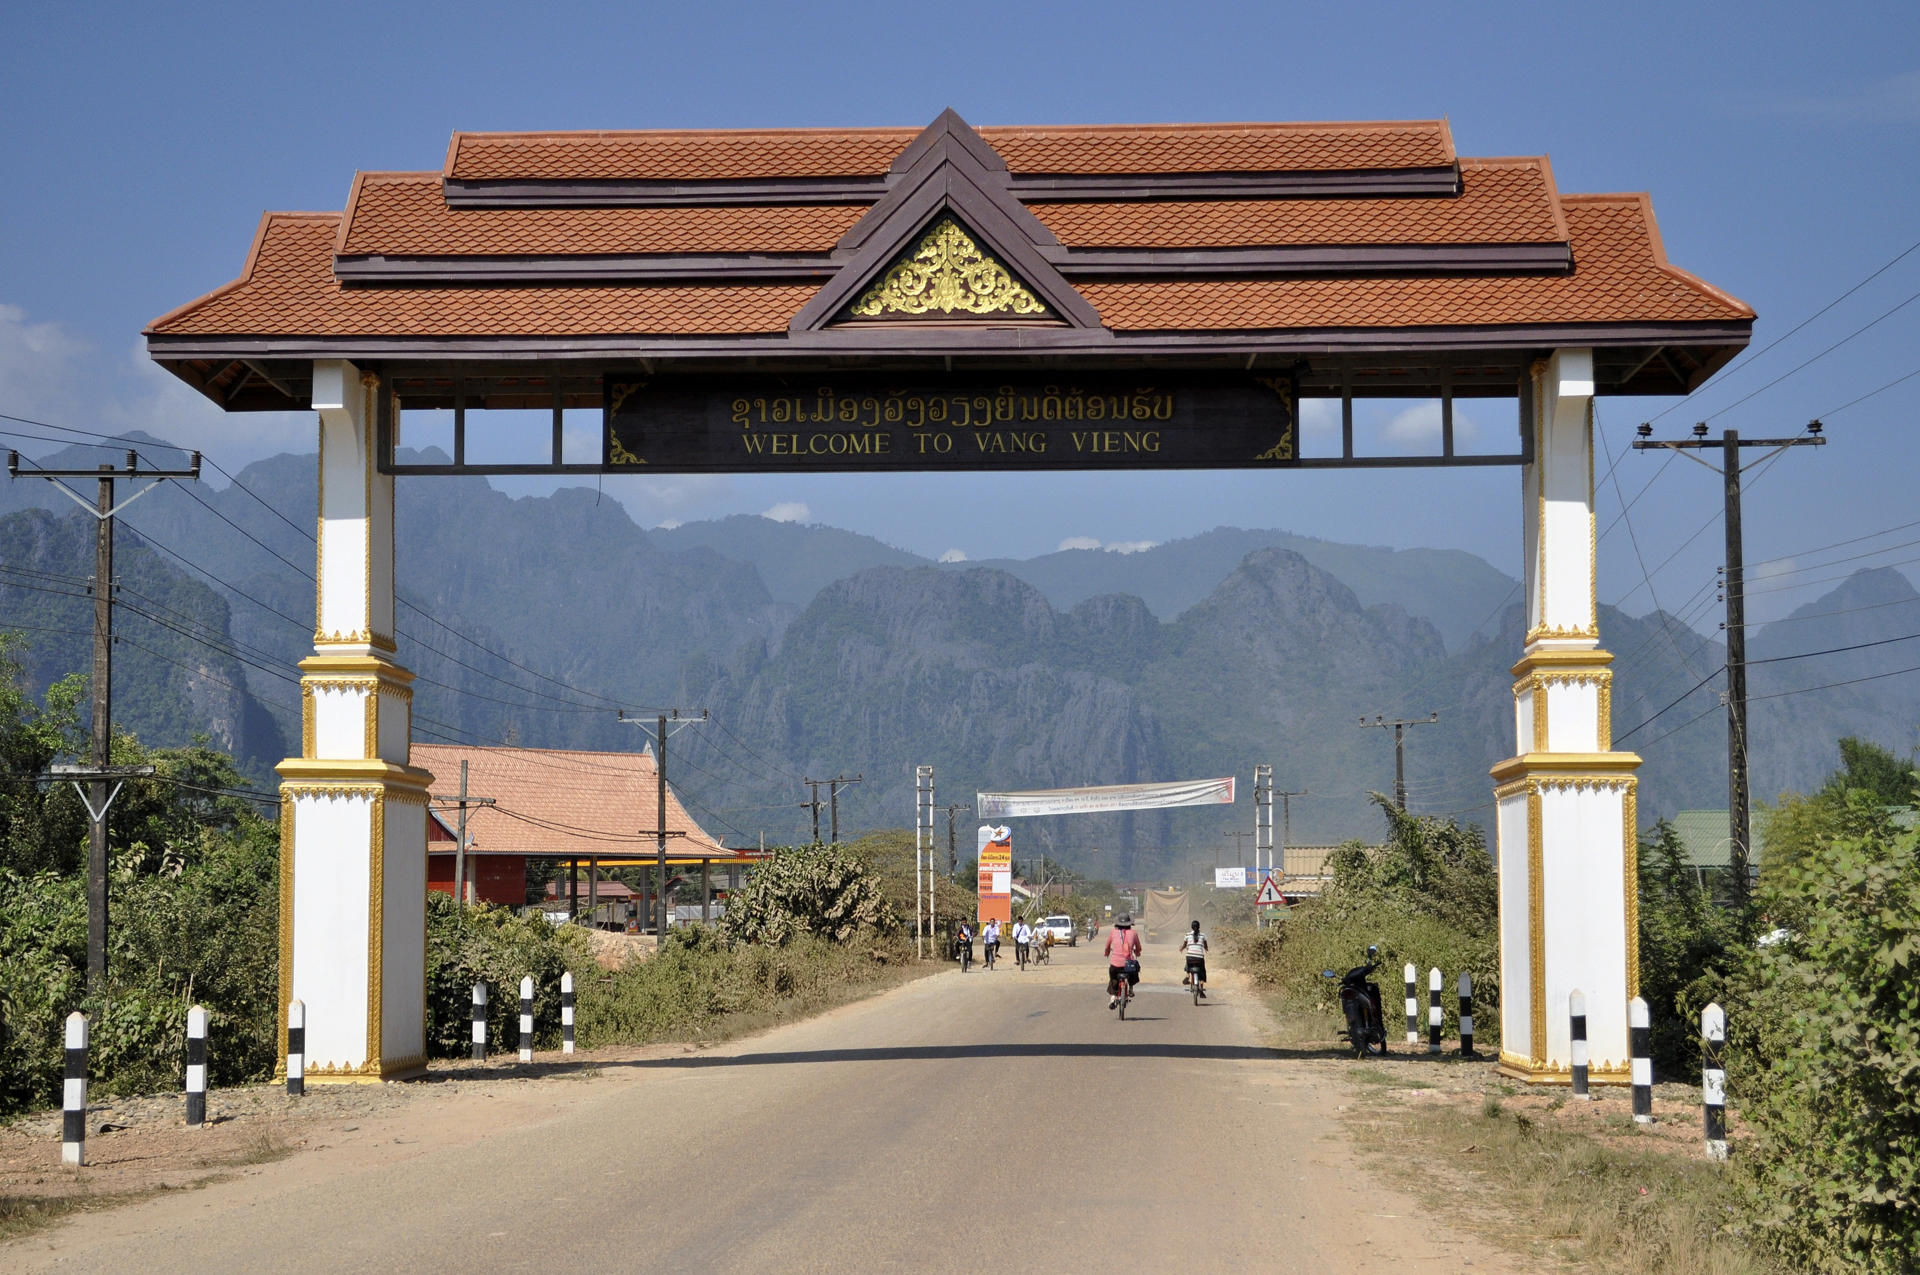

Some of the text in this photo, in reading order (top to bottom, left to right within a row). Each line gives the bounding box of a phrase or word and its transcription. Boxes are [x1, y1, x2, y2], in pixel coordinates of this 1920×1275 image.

[742, 432, 1160, 455] WELCOME TO VANG VIENG
